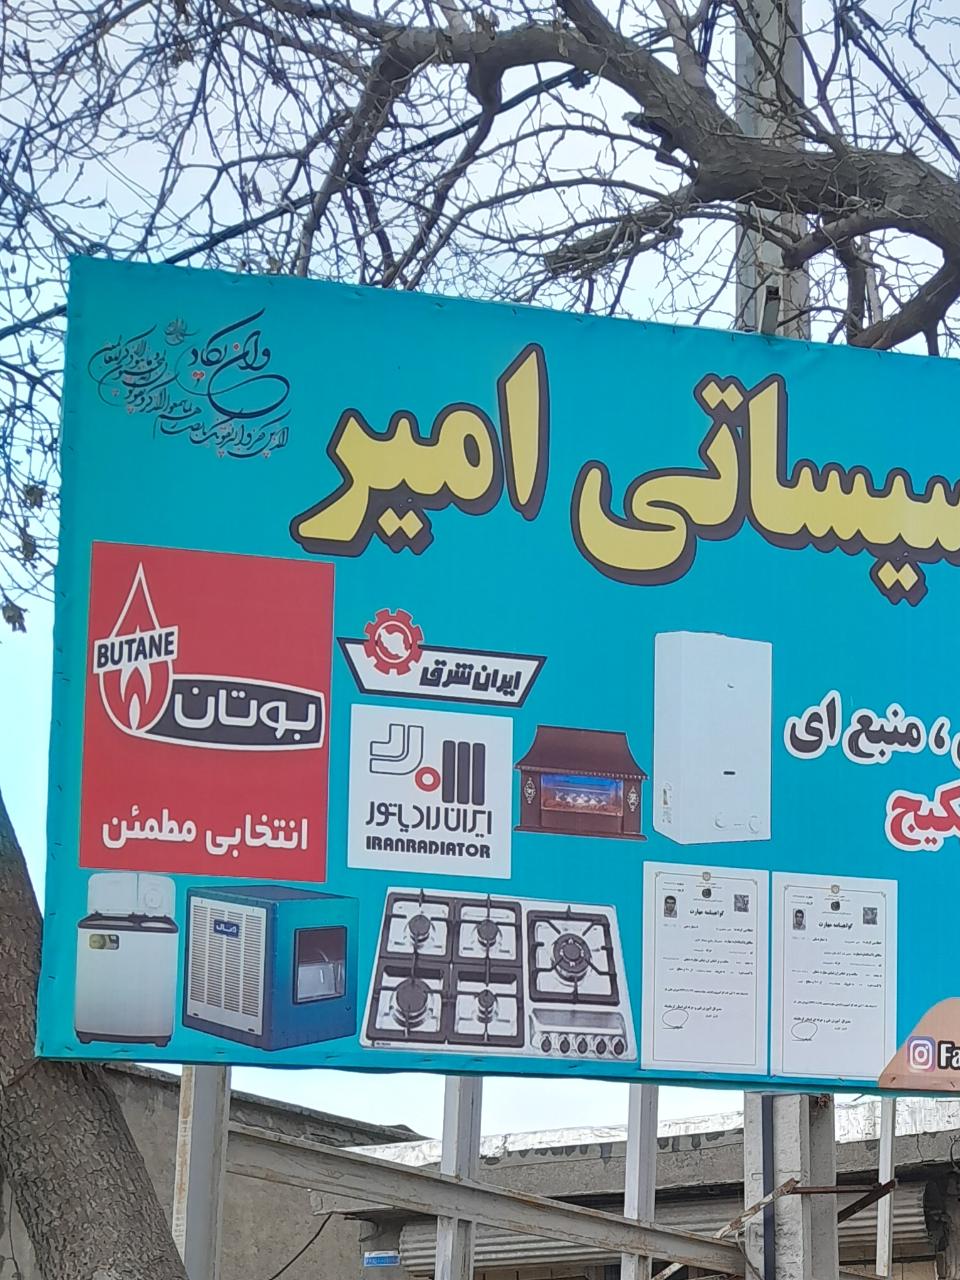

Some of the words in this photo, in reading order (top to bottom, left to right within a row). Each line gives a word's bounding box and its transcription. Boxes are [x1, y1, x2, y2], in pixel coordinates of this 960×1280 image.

[290, 342, 550, 556] امیر
[96, 630, 176, 669] BUTANE
[419, 659, 475, 688] شرق
[471, 664, 523, 697] ایران
[174, 686, 317, 740] بوتان
[789, 695, 839, 755] ای
[847, 708, 922, 760] منبع
[102, 804, 198, 849] مطمئن
[205, 813, 309, 858] انتخابی
[365, 835, 491, 860] IRANRADIATOR
